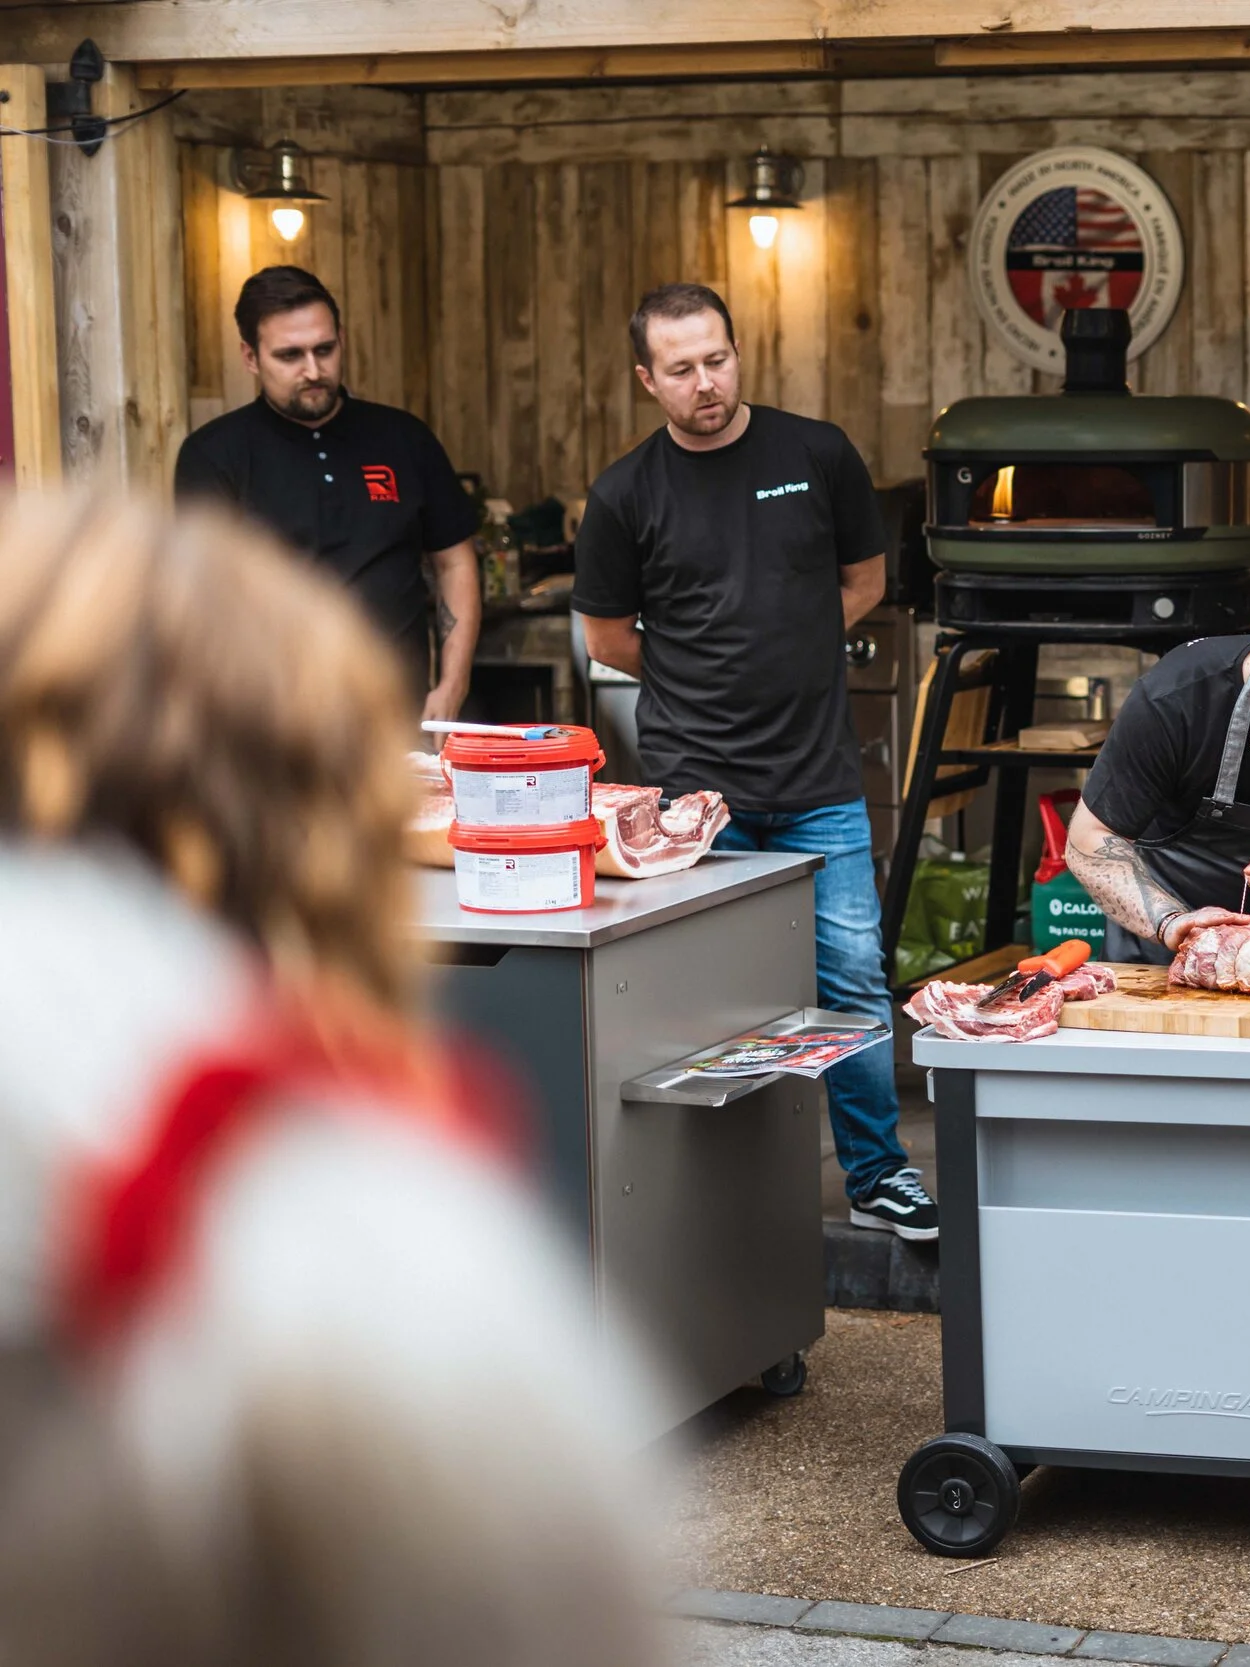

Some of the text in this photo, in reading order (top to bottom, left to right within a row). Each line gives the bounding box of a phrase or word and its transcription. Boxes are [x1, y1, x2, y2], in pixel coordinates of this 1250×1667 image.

[957, 467, 972, 484] G
[756, 482, 809, 500] Broil King
[1137, 532, 1171, 540] GOZNEY
[1062, 927, 1088, 937] PATIO
